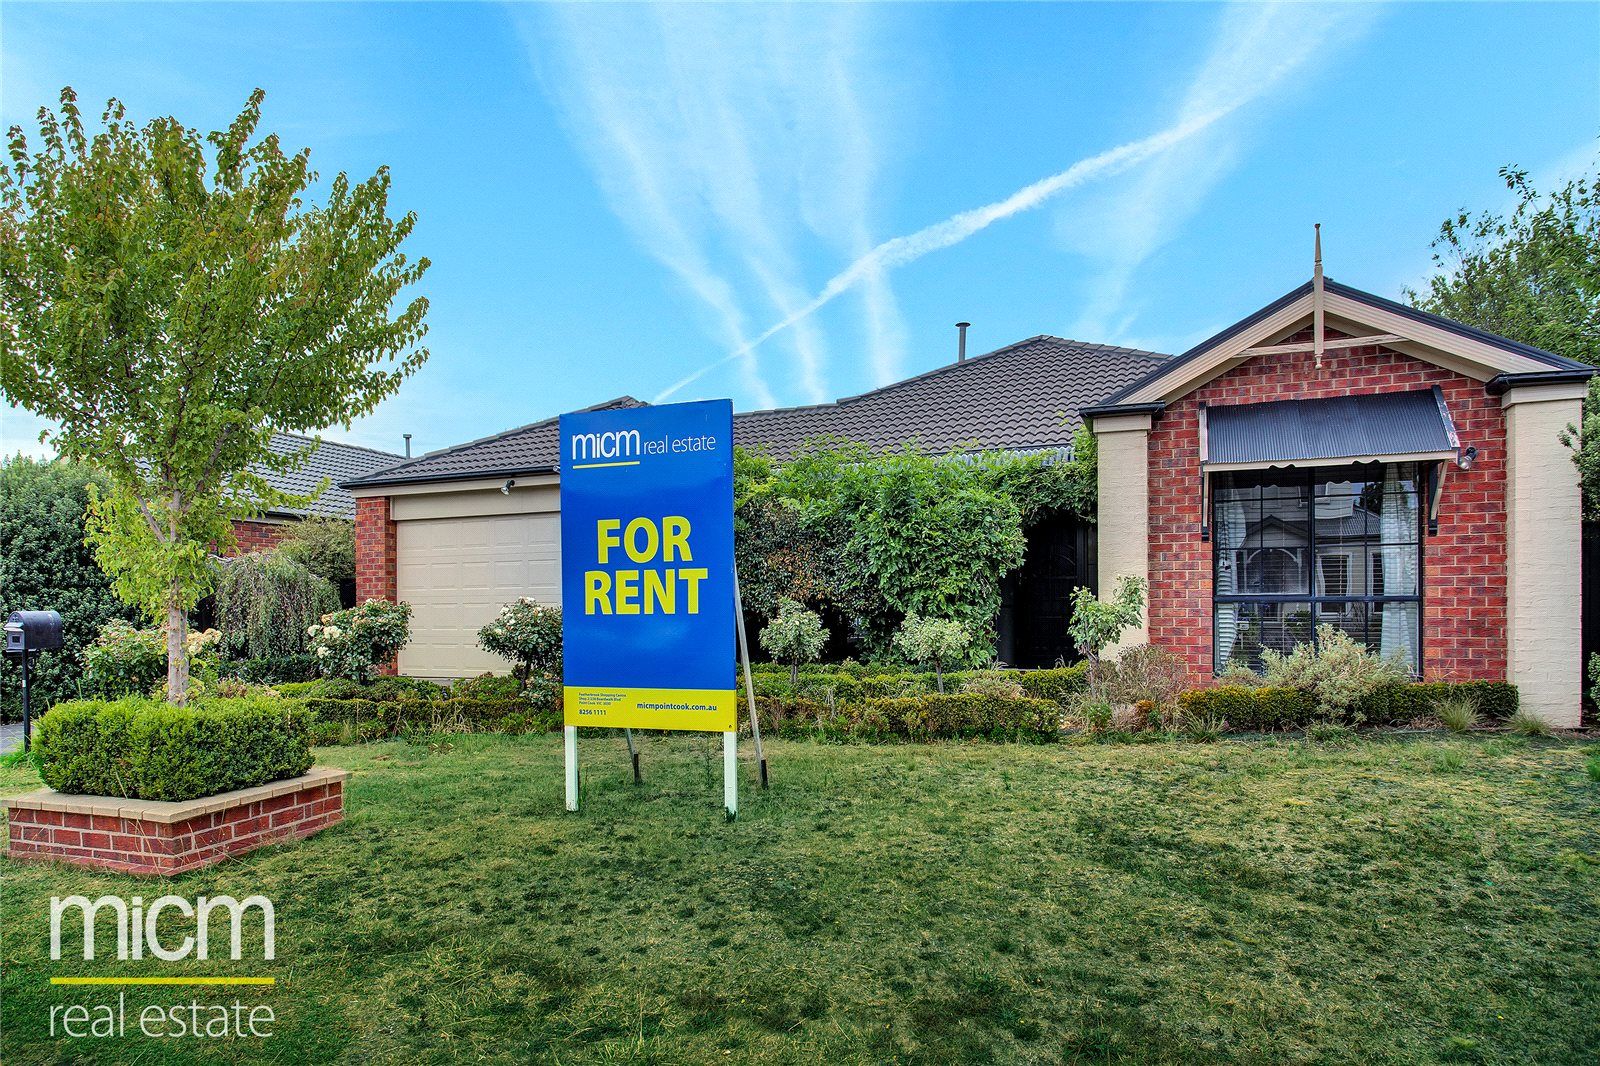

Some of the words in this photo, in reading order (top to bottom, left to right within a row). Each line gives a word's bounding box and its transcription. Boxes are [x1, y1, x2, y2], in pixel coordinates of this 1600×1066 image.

[572, 429, 641, 460] micm
[643, 435, 668, 455] real
[672, 434, 716, 453] estate
[597, 515, 693, 564] FOR
[584, 567, 708, 615] RENT
[636, 702, 717, 711] micmpointcook.com.au
